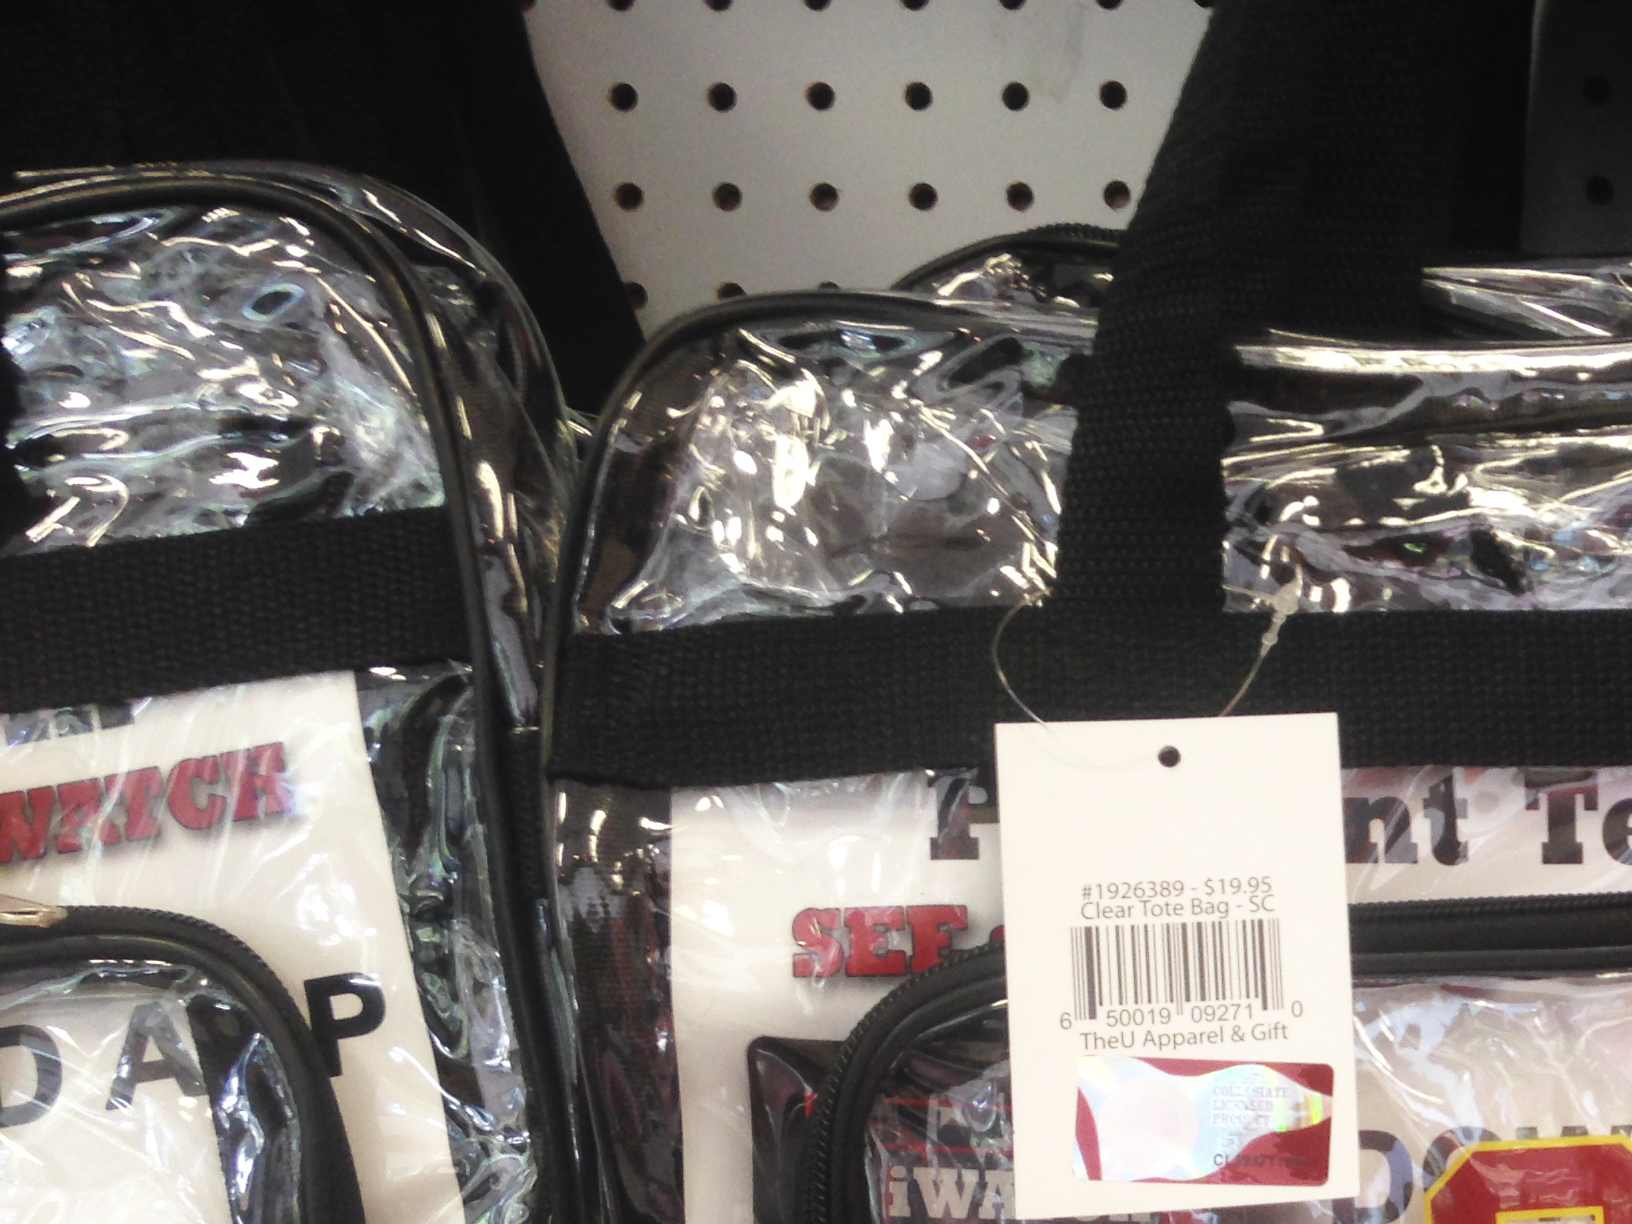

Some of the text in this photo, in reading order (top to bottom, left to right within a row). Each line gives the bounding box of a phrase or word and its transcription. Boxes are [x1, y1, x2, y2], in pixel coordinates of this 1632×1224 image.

[1082, 880, 1184, 900] #1926389
[1204, 876, 1272, 896] $19.95
[1081, 901, 1134, 920] Clear
[1139, 899, 1184, 917] Tote
[1190, 898, 1229, 919] Bag
[1249, 894, 1275, 913] SC
[1059, 1000, 1304, 1030] 6 50019 09271 0
[1080, 1021, 1290, 1051] TheU Apparel & Gift
